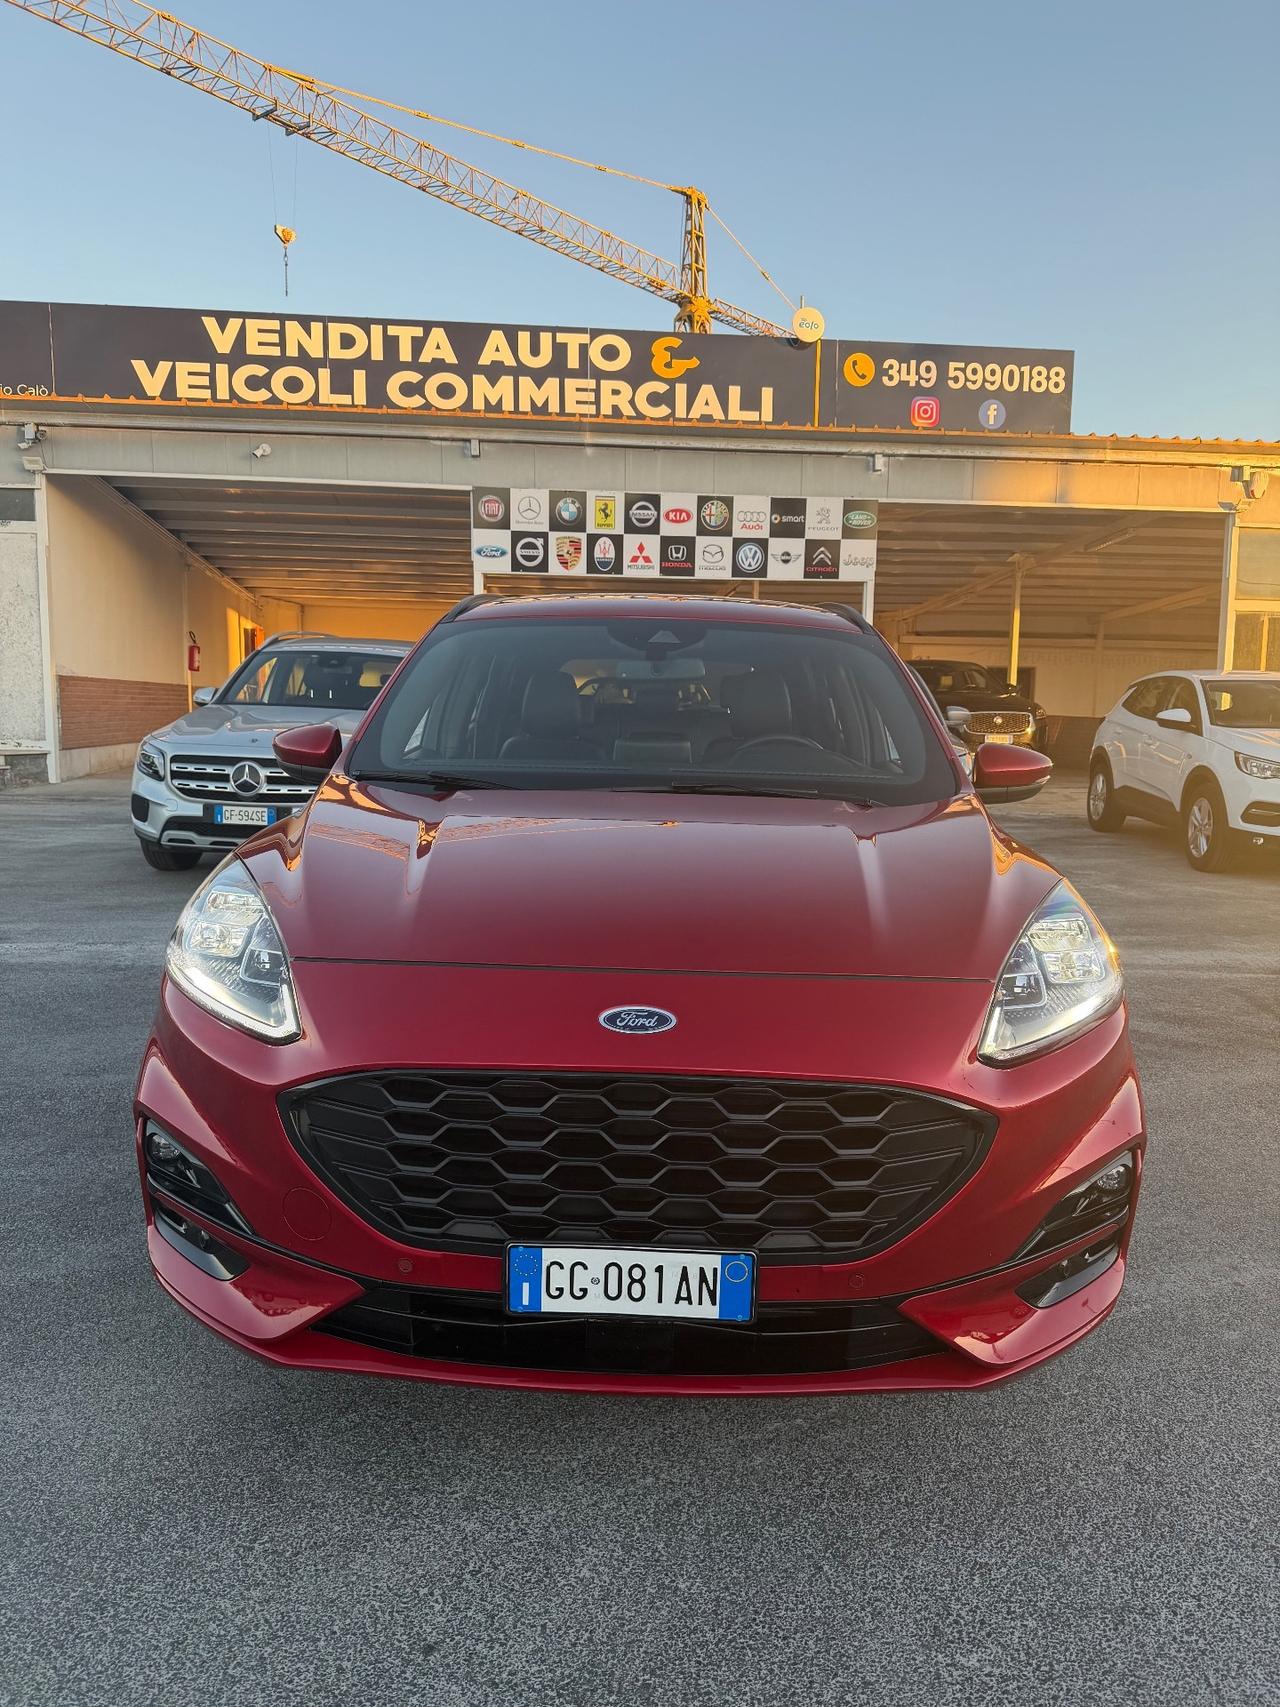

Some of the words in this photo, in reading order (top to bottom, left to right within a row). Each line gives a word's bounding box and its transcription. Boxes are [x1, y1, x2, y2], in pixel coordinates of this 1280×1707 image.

[201, 315, 459, 365] VENDITA
[478, 330, 632, 372] AUTO
[650, 336, 701, 379] &
[881, 358, 937, 388] 349
[947, 361, 1066, 394] 5990188
[130, 359, 368, 406] VEICOLI
[386, 370, 774, 422] COMMERCIALI
[484, 503, 500, 515] FIAT
[782, 514, 804, 523] smart
[740, 523, 763, 531] Audi
[480, 546, 501, 557] Ford
[661, 561, 693, 569] HONDA
[616, 1011, 659, 1027] Ford
